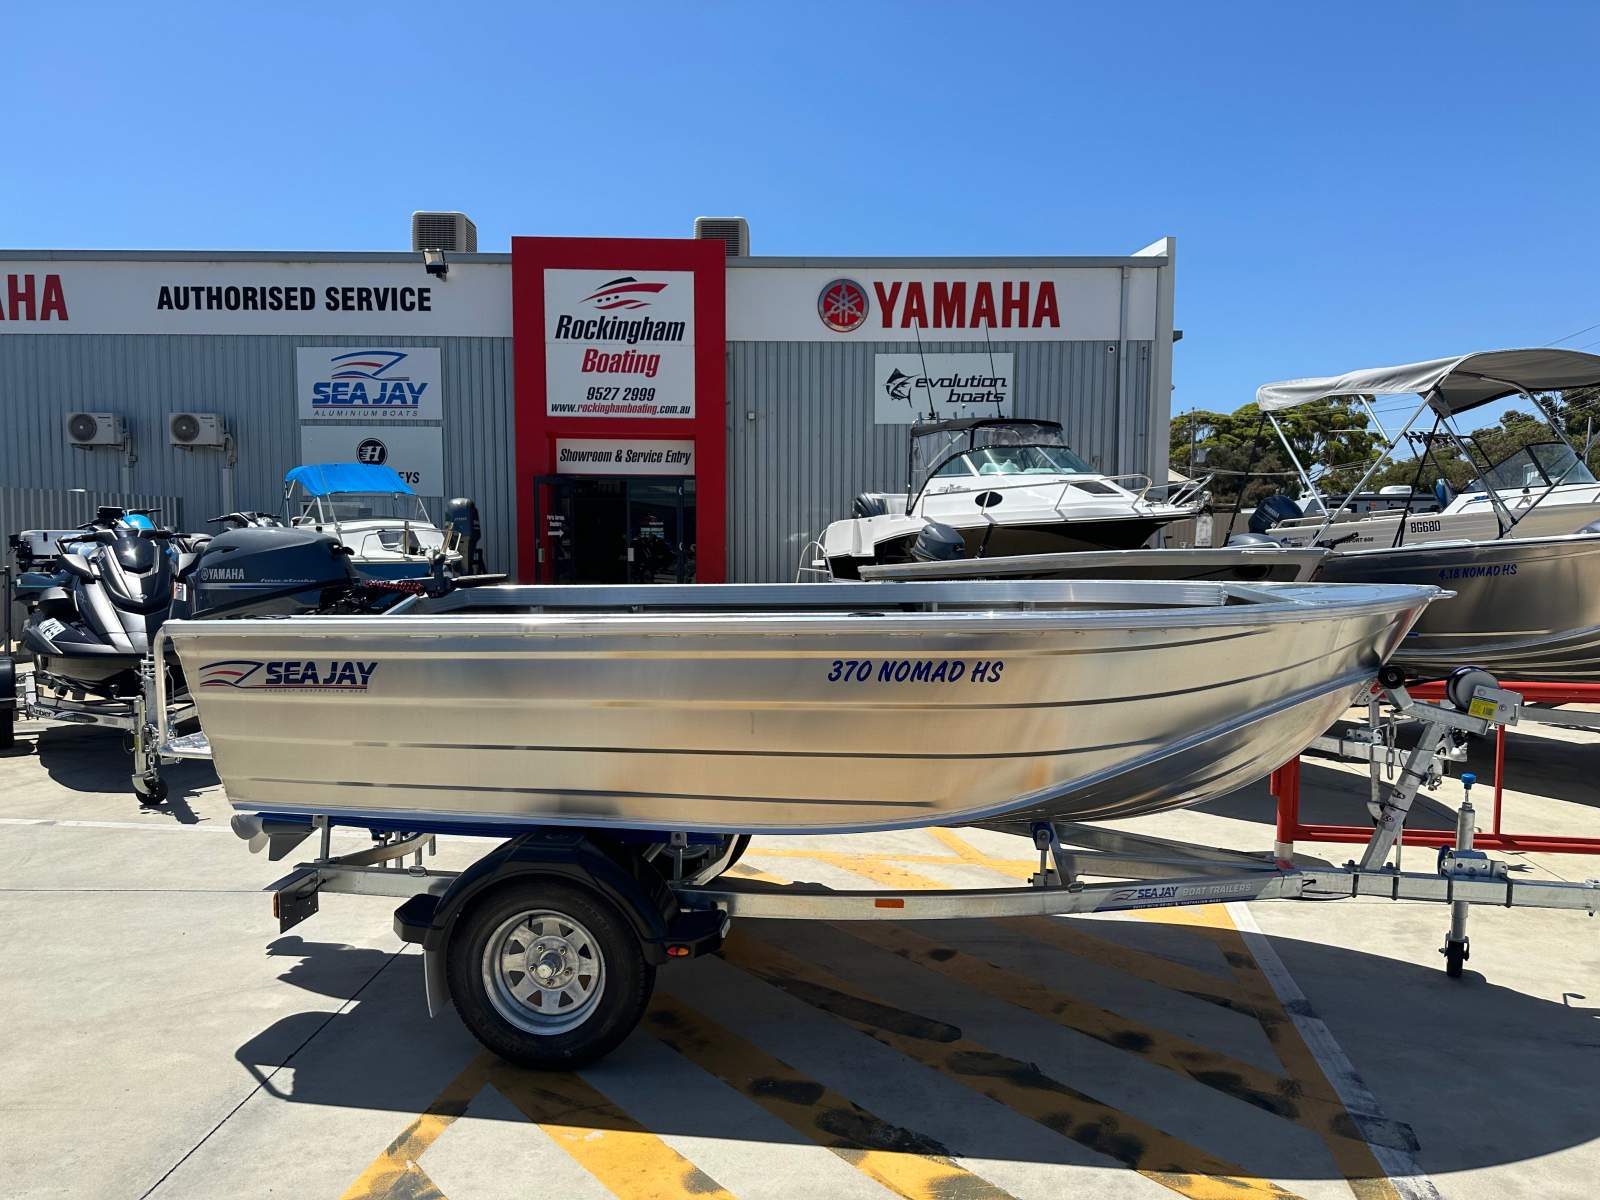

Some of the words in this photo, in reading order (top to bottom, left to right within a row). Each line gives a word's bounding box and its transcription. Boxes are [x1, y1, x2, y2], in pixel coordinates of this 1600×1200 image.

[0, 274, 69, 321] HA
[157, 285, 315, 311] AUTHORISED
[325, 286, 432, 312] SERVICE
[873, 281, 1060, 328] YAMAHA
[555, 314, 686, 344] Rockingham
[581, 348, 661, 378] Boating
[915, 373, 1008, 388] evolution
[312, 382, 369, 405] SEA
[372, 382, 428, 405] JAY
[586, 386, 620, 401] 9527
[622, 387, 656, 401] 2999
[946, 389, 1007, 403] boats
[551, 403, 691, 415] www.rockinghamboating.com.au
[560, 448, 613, 463] Showroom
[615, 449, 623, 463] &
[625, 449, 663, 463] Service
[665, 450, 692, 466] Entry
[208, 568, 245, 580] YAMAHA
[1461, 565, 1501, 578] NOMAD
[1502, 563, 1518, 576] HS
[265, 661, 320, 685] SEA
[323, 661, 378, 685] JAY
[827, 659, 873, 682] 370
[877, 660, 966, 683] NOMAD
[970, 660, 1004, 683] HS
[1137, 887, 1159, 898] SEA
[1158, 886, 1179, 897] JAY
[1183, 886, 1208, 896] BOAT
[1209, 884, 1252, 895] TRAILERS
